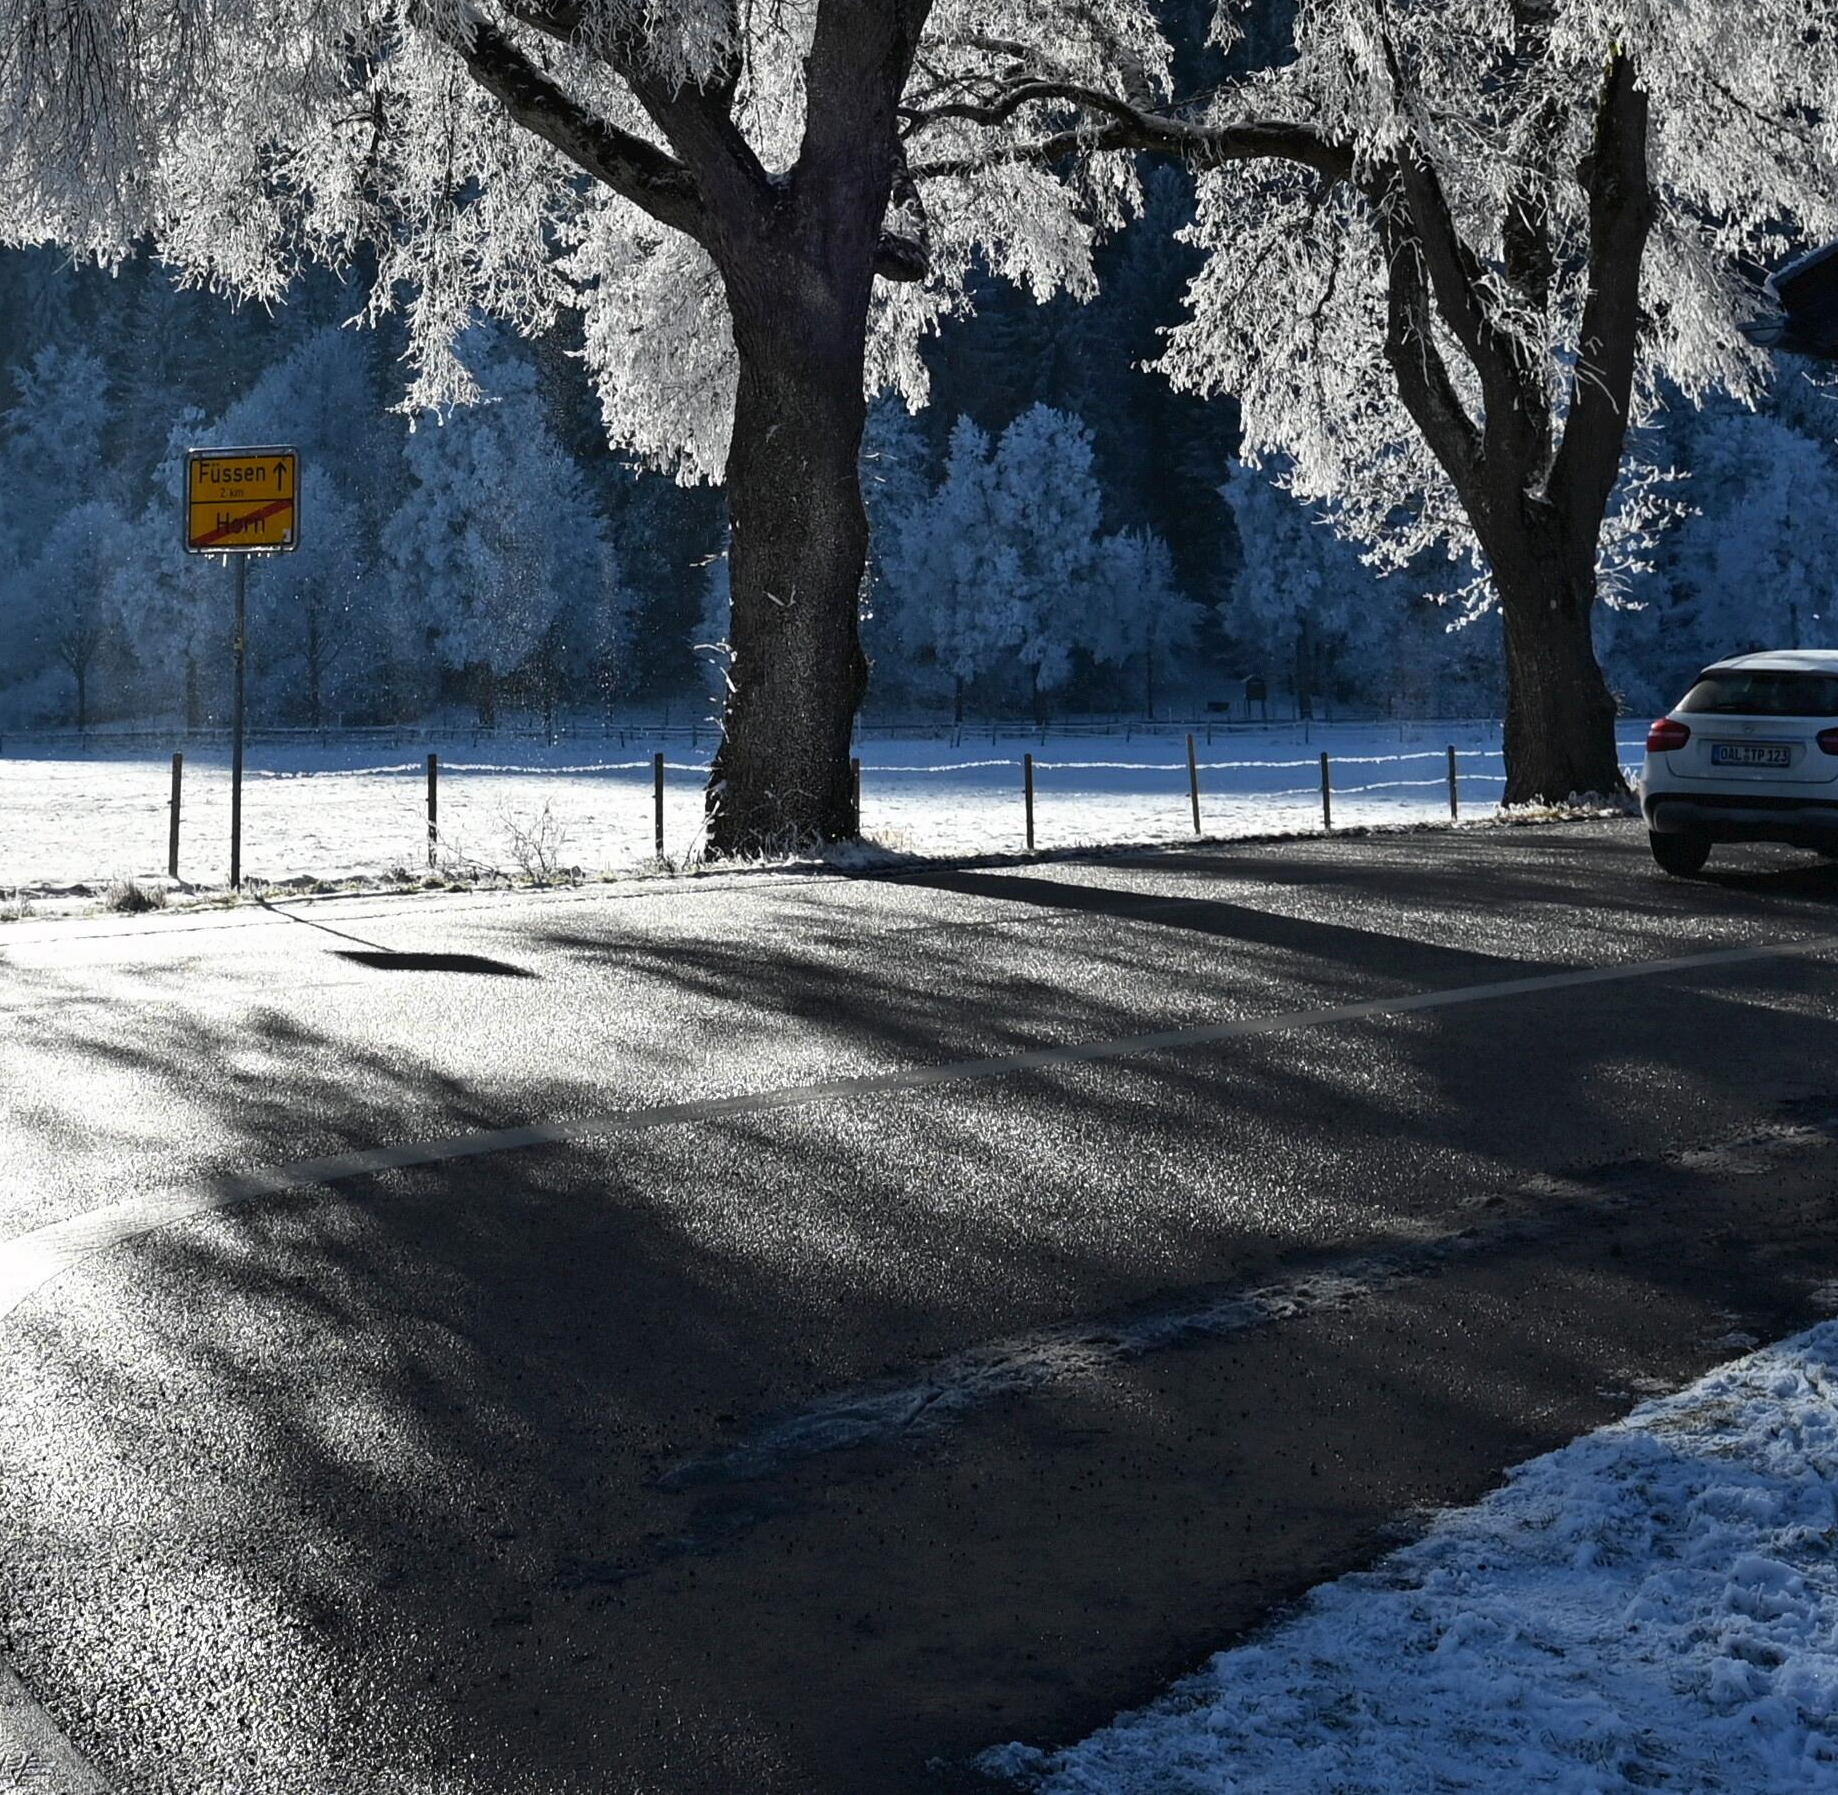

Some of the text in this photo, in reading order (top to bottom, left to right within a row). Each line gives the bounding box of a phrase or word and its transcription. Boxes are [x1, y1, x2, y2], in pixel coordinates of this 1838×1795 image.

[199, 463, 266, 484] Füssen
[220, 488, 244, 498] 2 km
[216, 512, 266, 534] Horn
[1721, 748, 1742, 760] OAL
